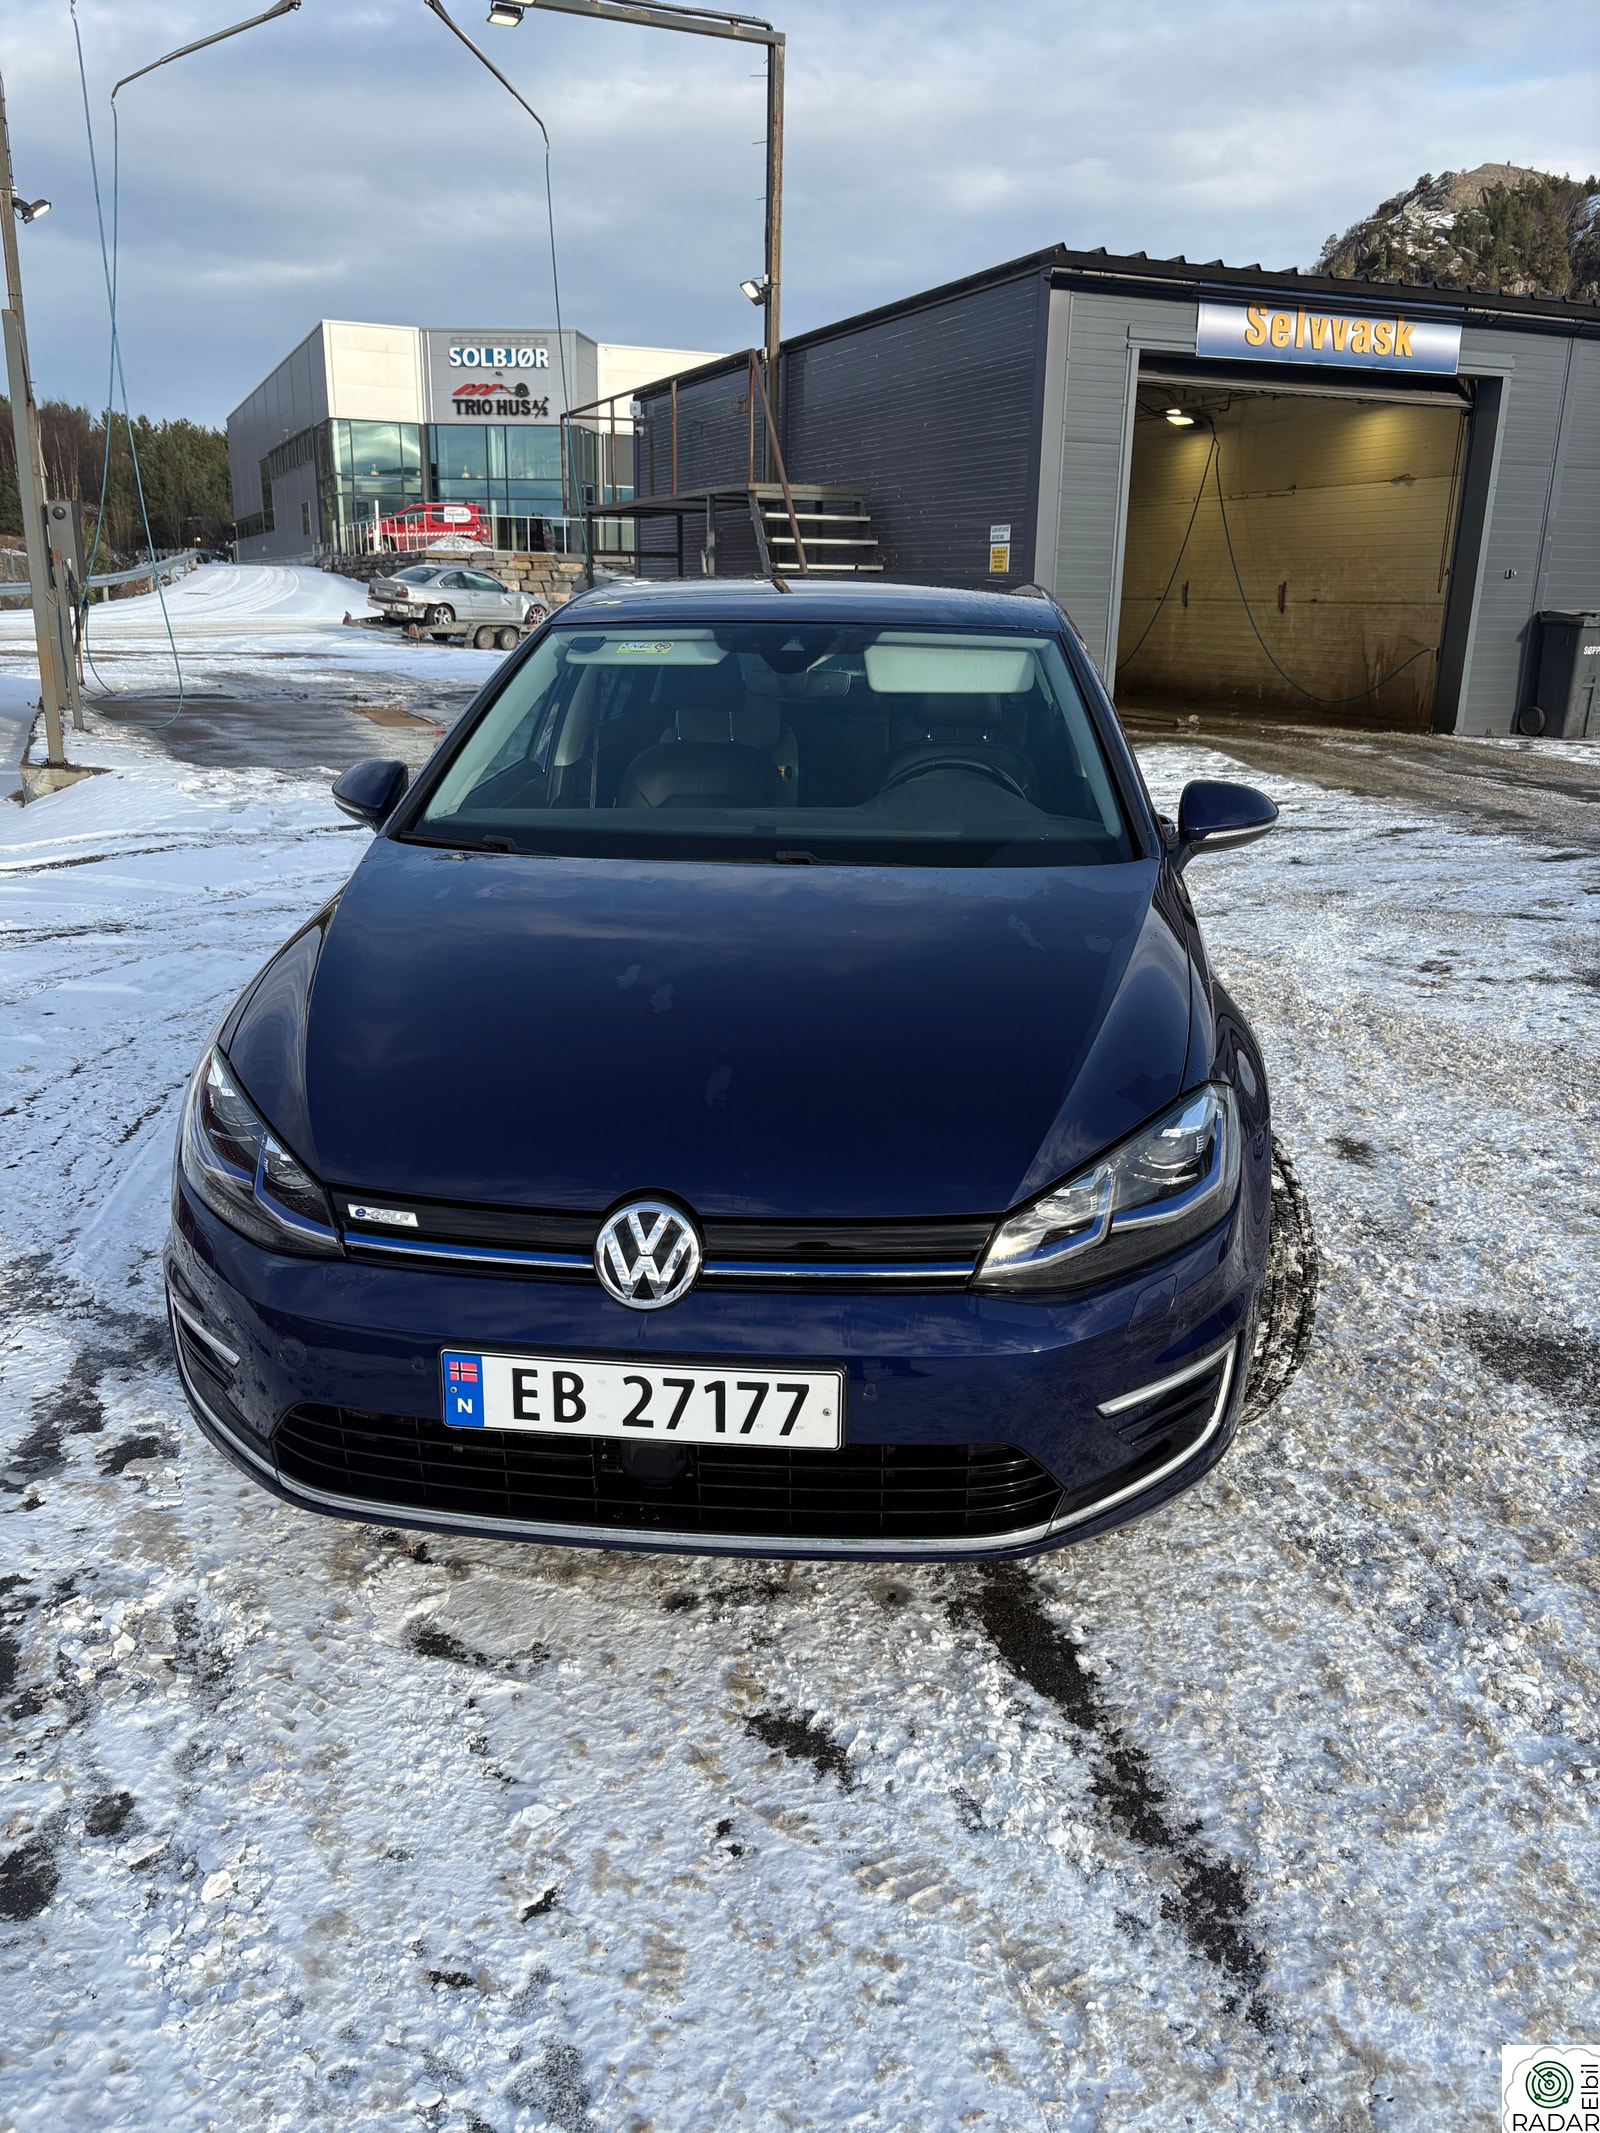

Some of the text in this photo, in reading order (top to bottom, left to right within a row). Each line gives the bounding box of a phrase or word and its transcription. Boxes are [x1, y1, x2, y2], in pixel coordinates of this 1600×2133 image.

[1244, 300, 1416, 358] Selvvask
[449, 347, 549, 368] SOLBJØR
[452, 397, 549, 418] TRIO HUS A/S
[457, 1398, 473, 1414] N
[512, 1367, 810, 1436] EB 27177
